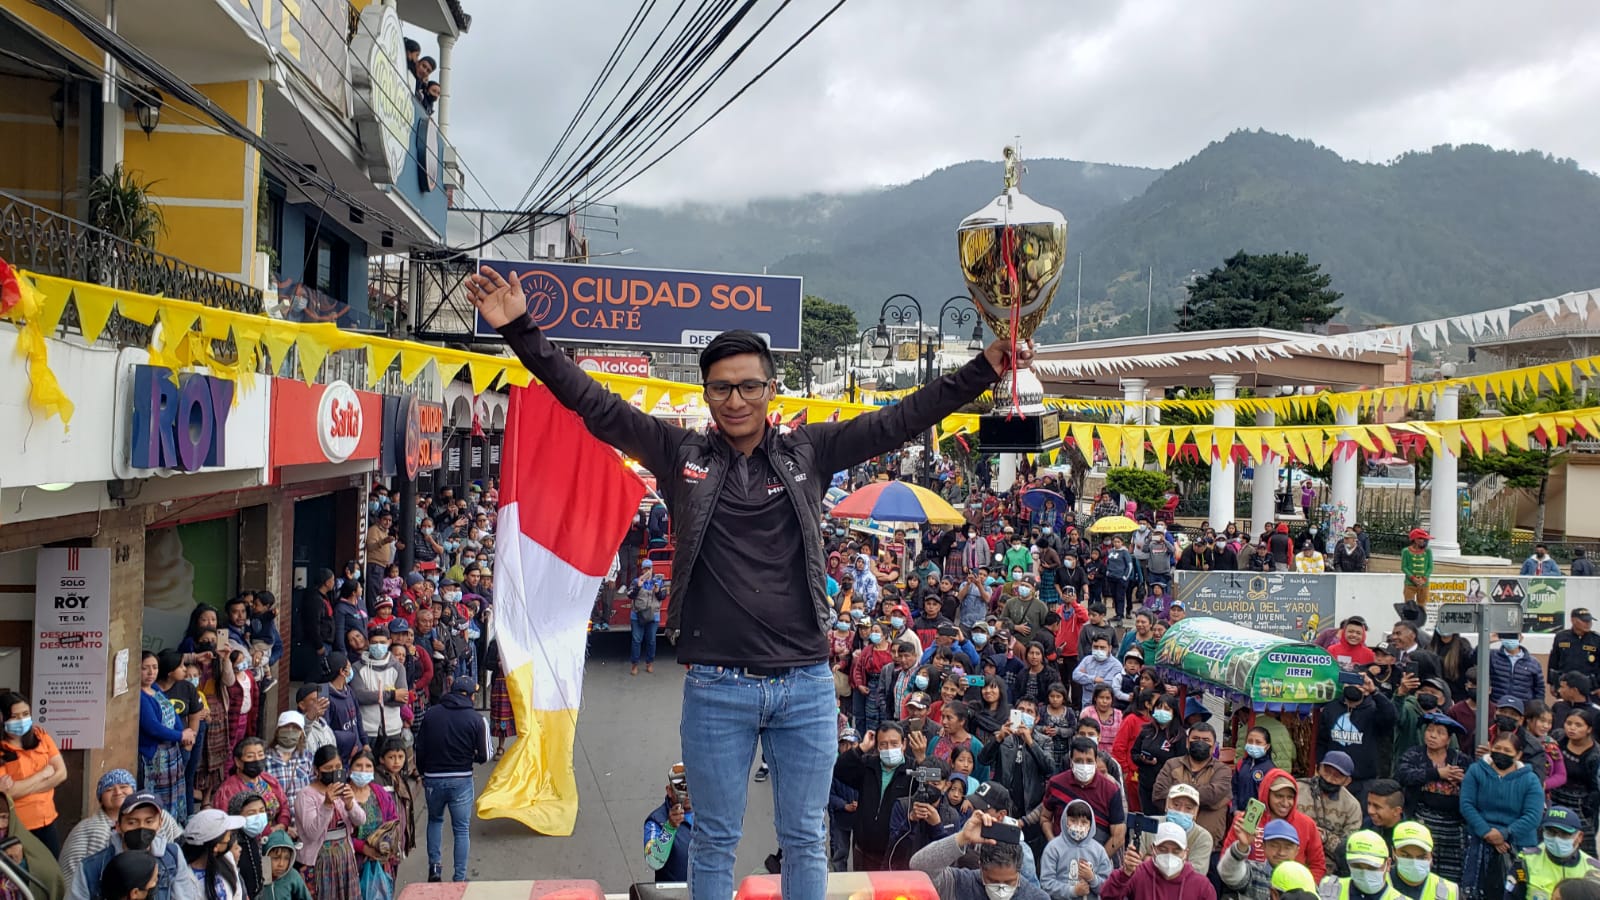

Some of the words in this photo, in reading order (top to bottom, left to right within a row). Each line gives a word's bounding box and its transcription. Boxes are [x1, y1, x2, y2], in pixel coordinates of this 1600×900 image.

[572, 276, 702, 309] CIUDAD
[710, 283, 773, 312] SOL
[571, 306, 642, 331] CAFÉ
[601, 361, 647, 374] KoKoa
[132, 364, 235, 471] ROY
[331, 398, 360, 439] Sarita
[60, 579, 86, 587] SOLO
[54, 594, 90, 609] ROY
[1212, 601, 1256, 613] GUARIDA
[1259, 601, 1280, 613] DEL
[1256, 613, 1288, 621] JUVENIL
[40, 631, 103, 639] DESCUENTO
[40, 641, 103, 649] DESCUENTO
[1189, 637, 1232, 662] JIREH
[1268, 653, 1332, 666] CEVINACHOS
[1285, 667, 1313, 678] JIREH
